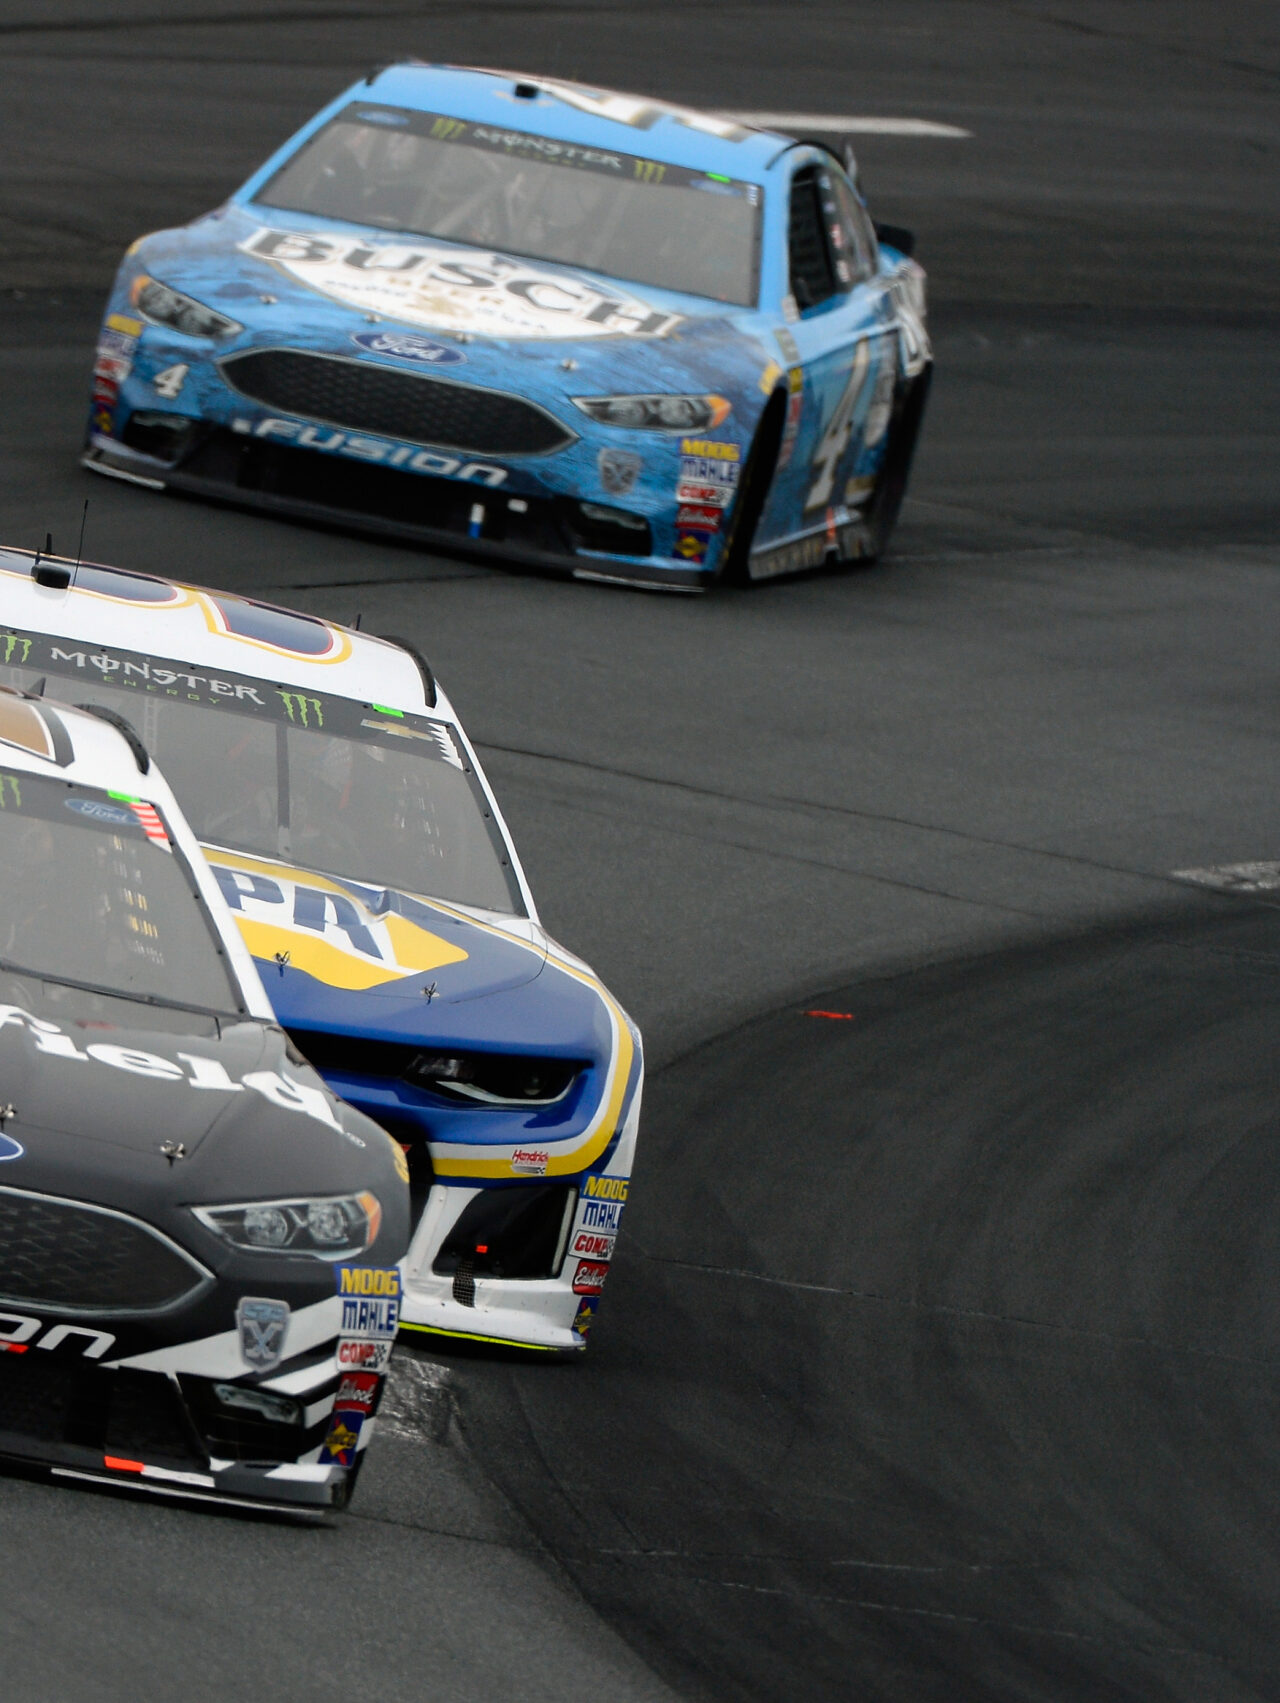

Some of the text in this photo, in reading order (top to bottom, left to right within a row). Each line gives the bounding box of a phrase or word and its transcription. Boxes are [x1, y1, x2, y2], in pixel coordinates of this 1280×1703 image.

[473, 127, 622, 168] MONSTER
[242, 229, 678, 337] BUSCH
[154, 363, 189, 398] 4
[253, 417, 508, 488] FUSION
[51, 646, 266, 705] MONSTER
[103, 674, 221, 705] ENERGY
[583, 1176, 630, 1201] MOOG
[340, 1267, 399, 1296] MOOG
[342, 1300, 397, 1332] MAHLE
[339, 1343, 375, 1363] COMP
